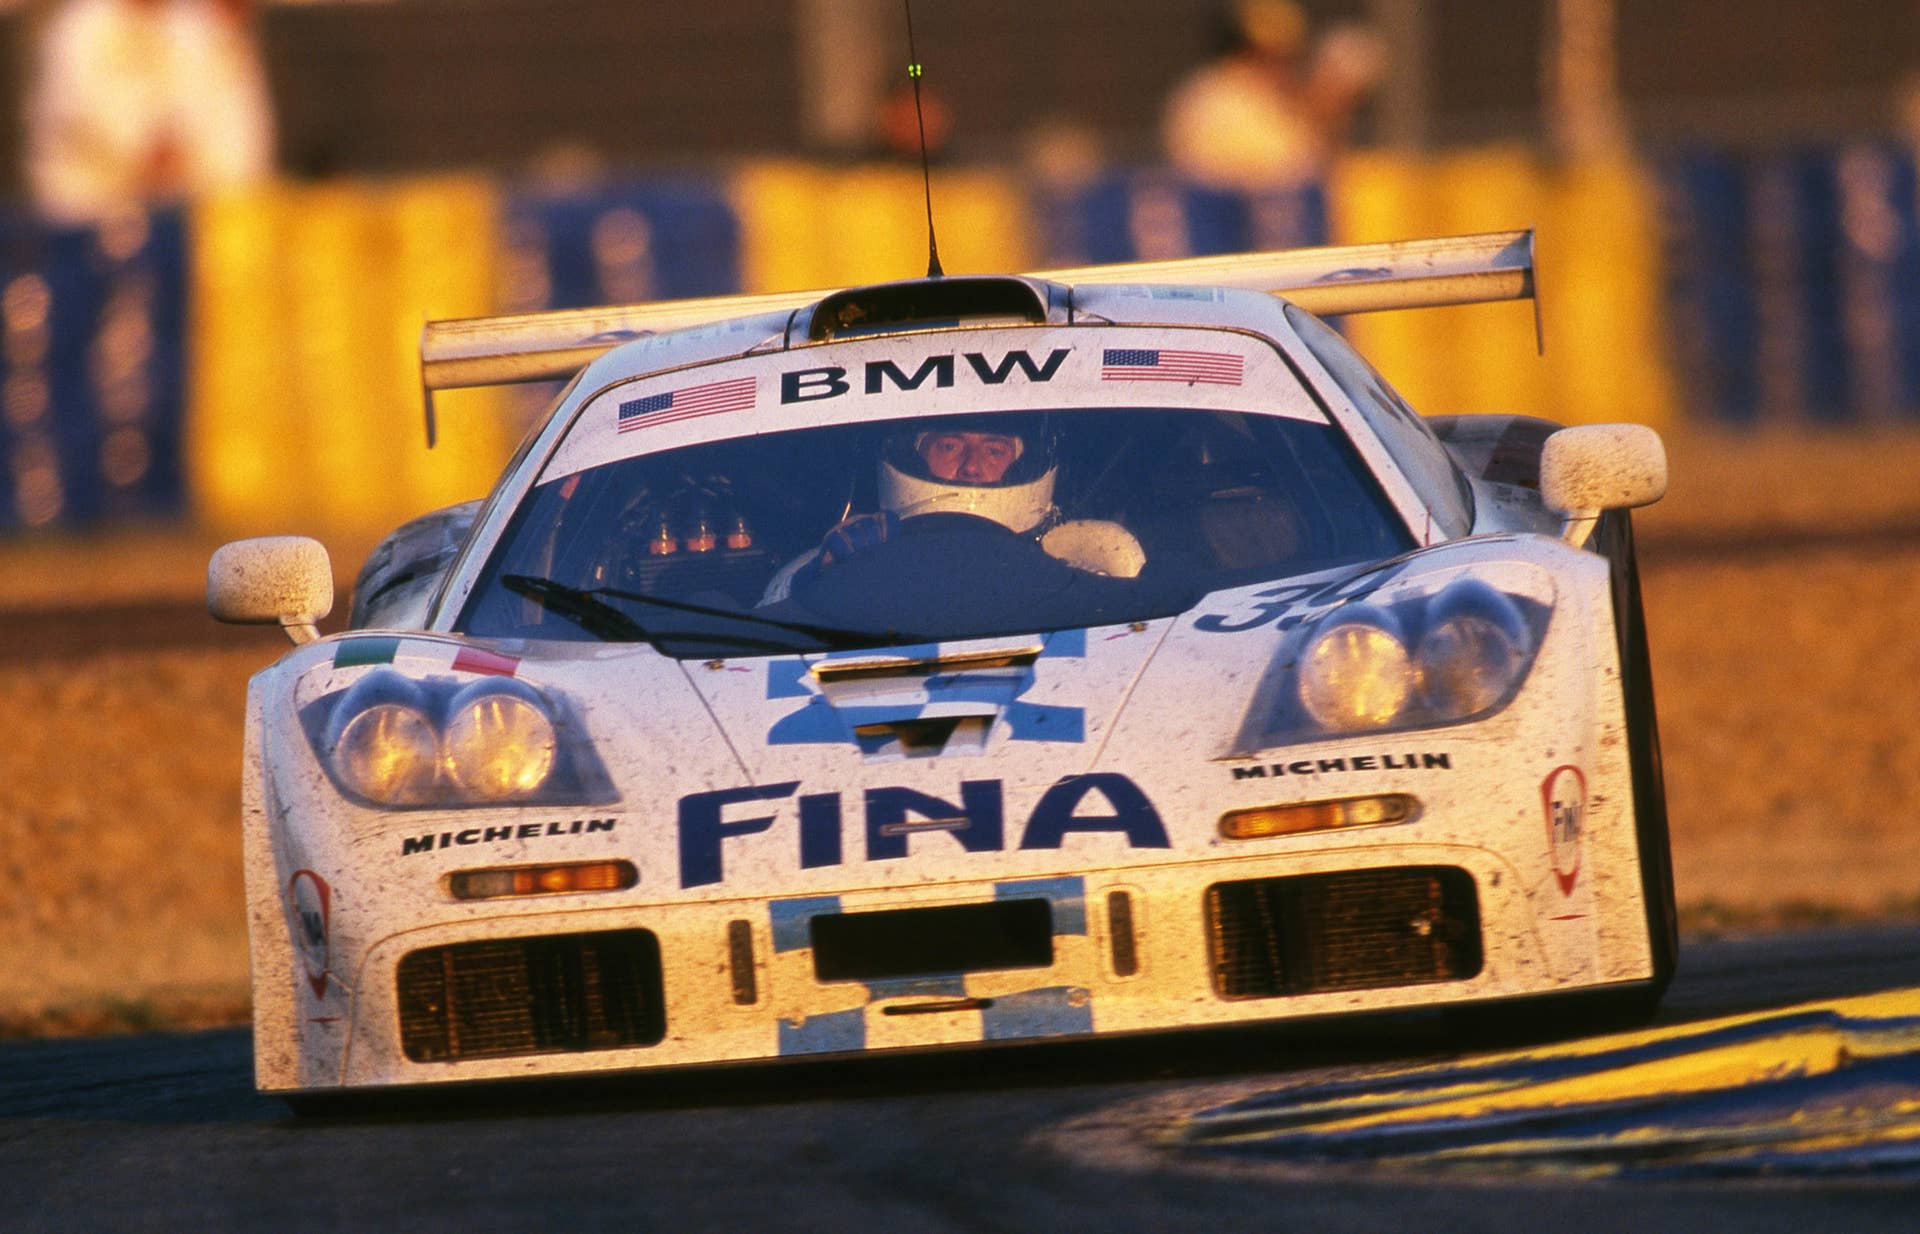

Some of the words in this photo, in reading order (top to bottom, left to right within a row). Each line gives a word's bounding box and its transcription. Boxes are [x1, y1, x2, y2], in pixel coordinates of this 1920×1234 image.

[780, 348, 1072, 404] BMW
[1232, 753, 1452, 780] MICHELIN
[402, 818, 617, 856] MICHELIN
[678, 772, 1172, 889] FINA
